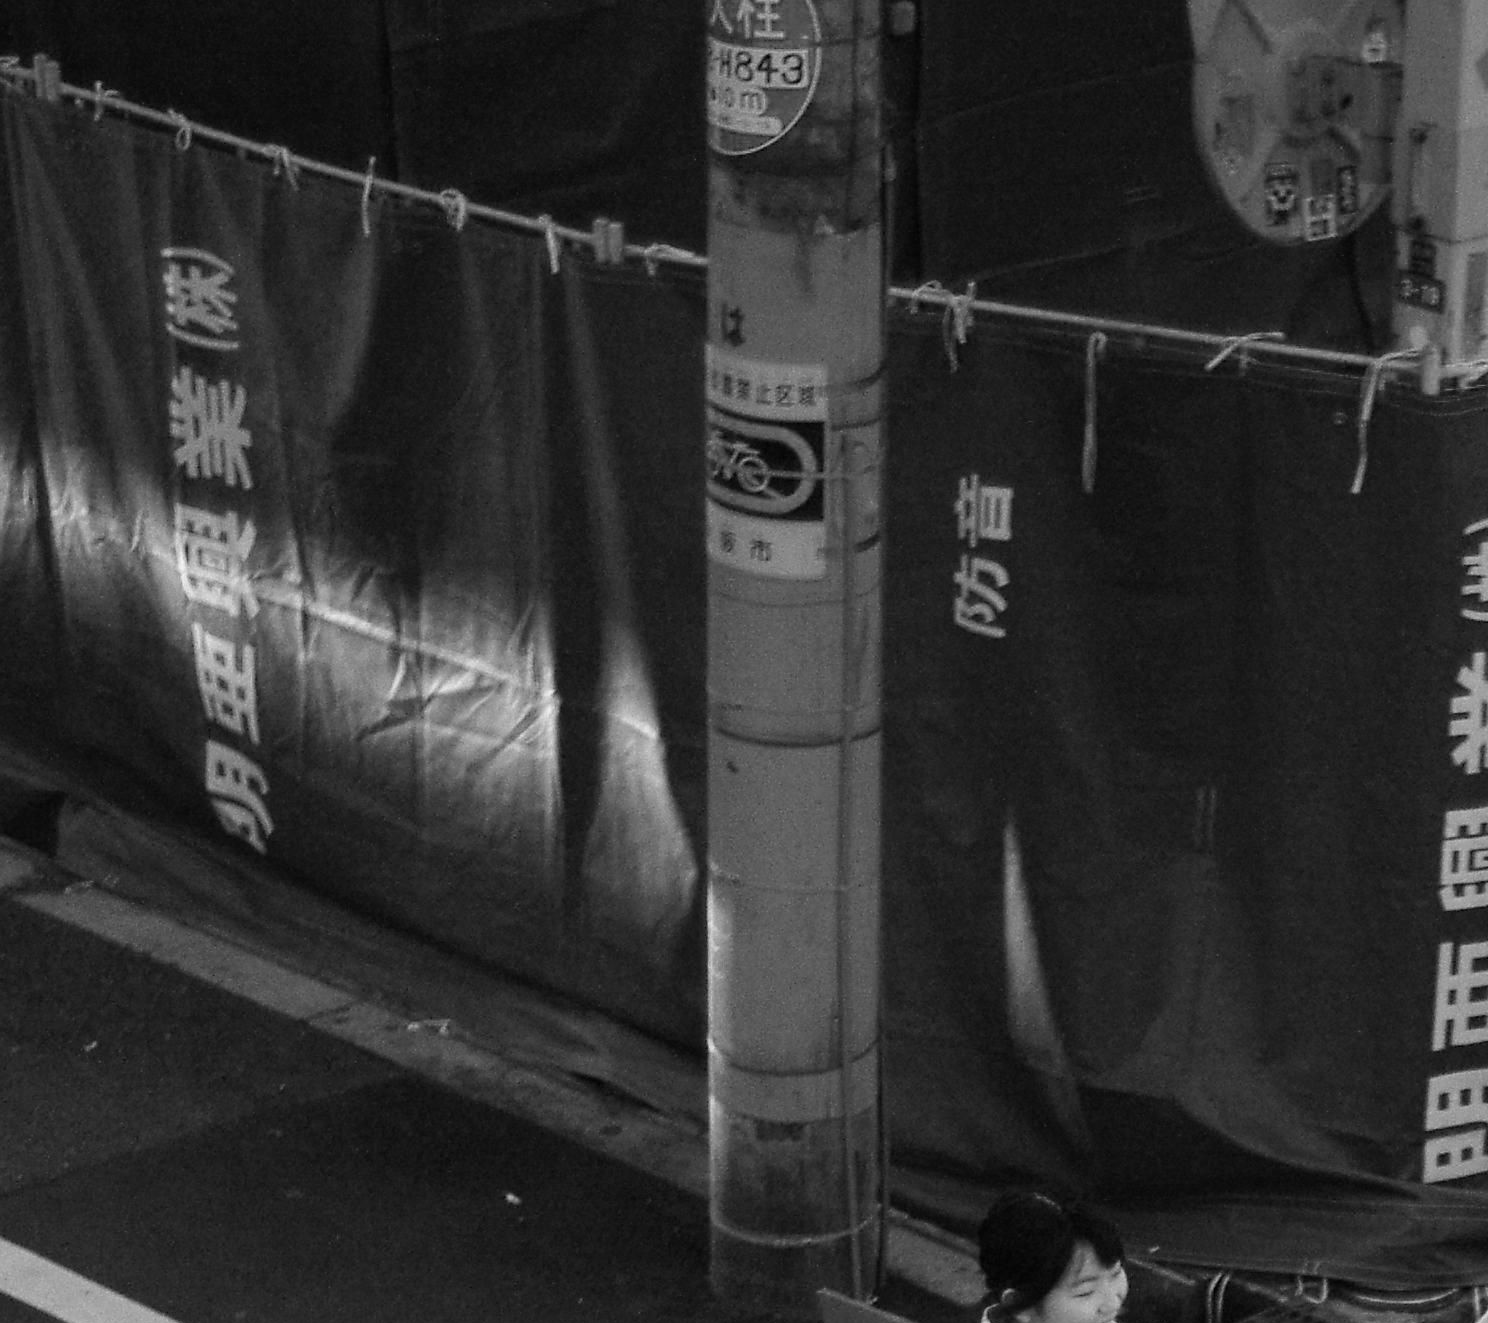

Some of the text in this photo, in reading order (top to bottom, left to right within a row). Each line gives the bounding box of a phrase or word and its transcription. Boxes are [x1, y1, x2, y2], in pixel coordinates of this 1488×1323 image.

[162, 246, 273, 854] 明亜興業(株)
[953, 474, 1014, 639] 防音
